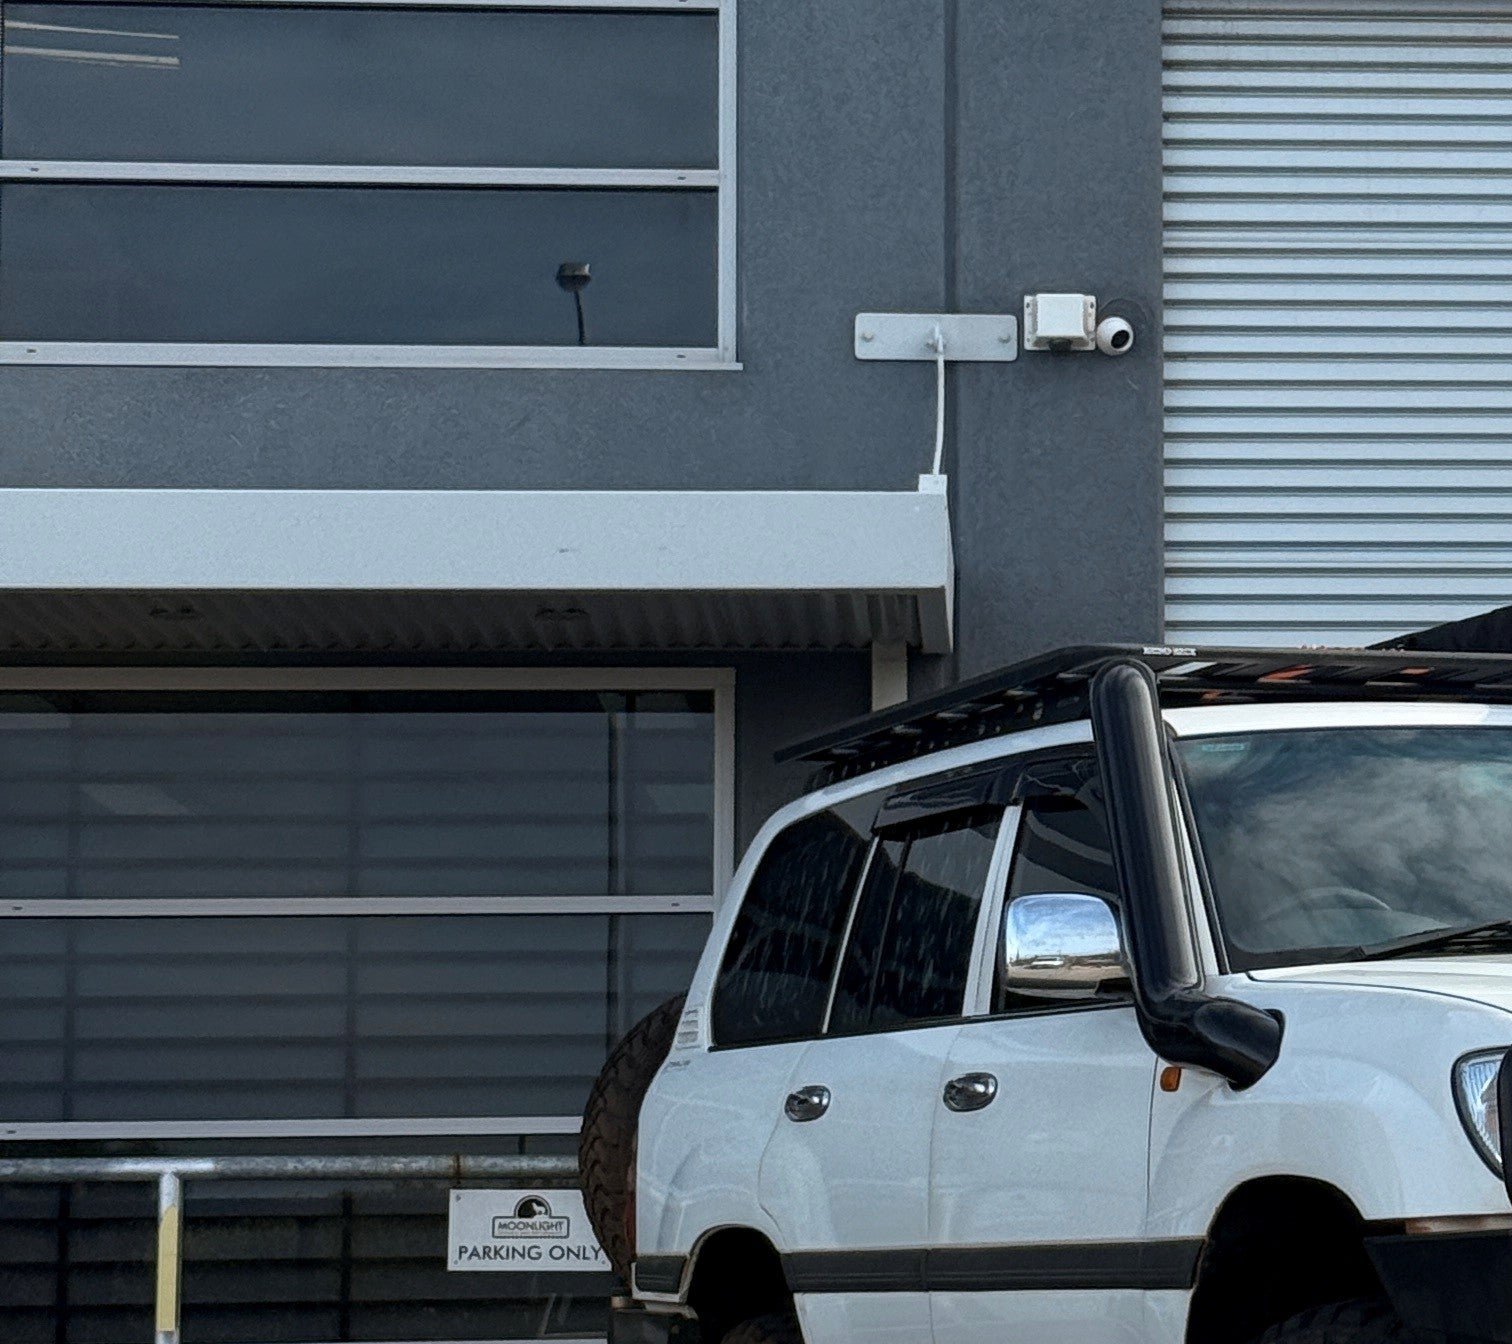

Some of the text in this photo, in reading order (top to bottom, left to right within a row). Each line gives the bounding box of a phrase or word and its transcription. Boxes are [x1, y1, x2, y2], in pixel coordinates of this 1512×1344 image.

[498, 1221, 564, 1231] MOONLIGHT
[459, 1245, 601, 1260] PARKING ONLY
